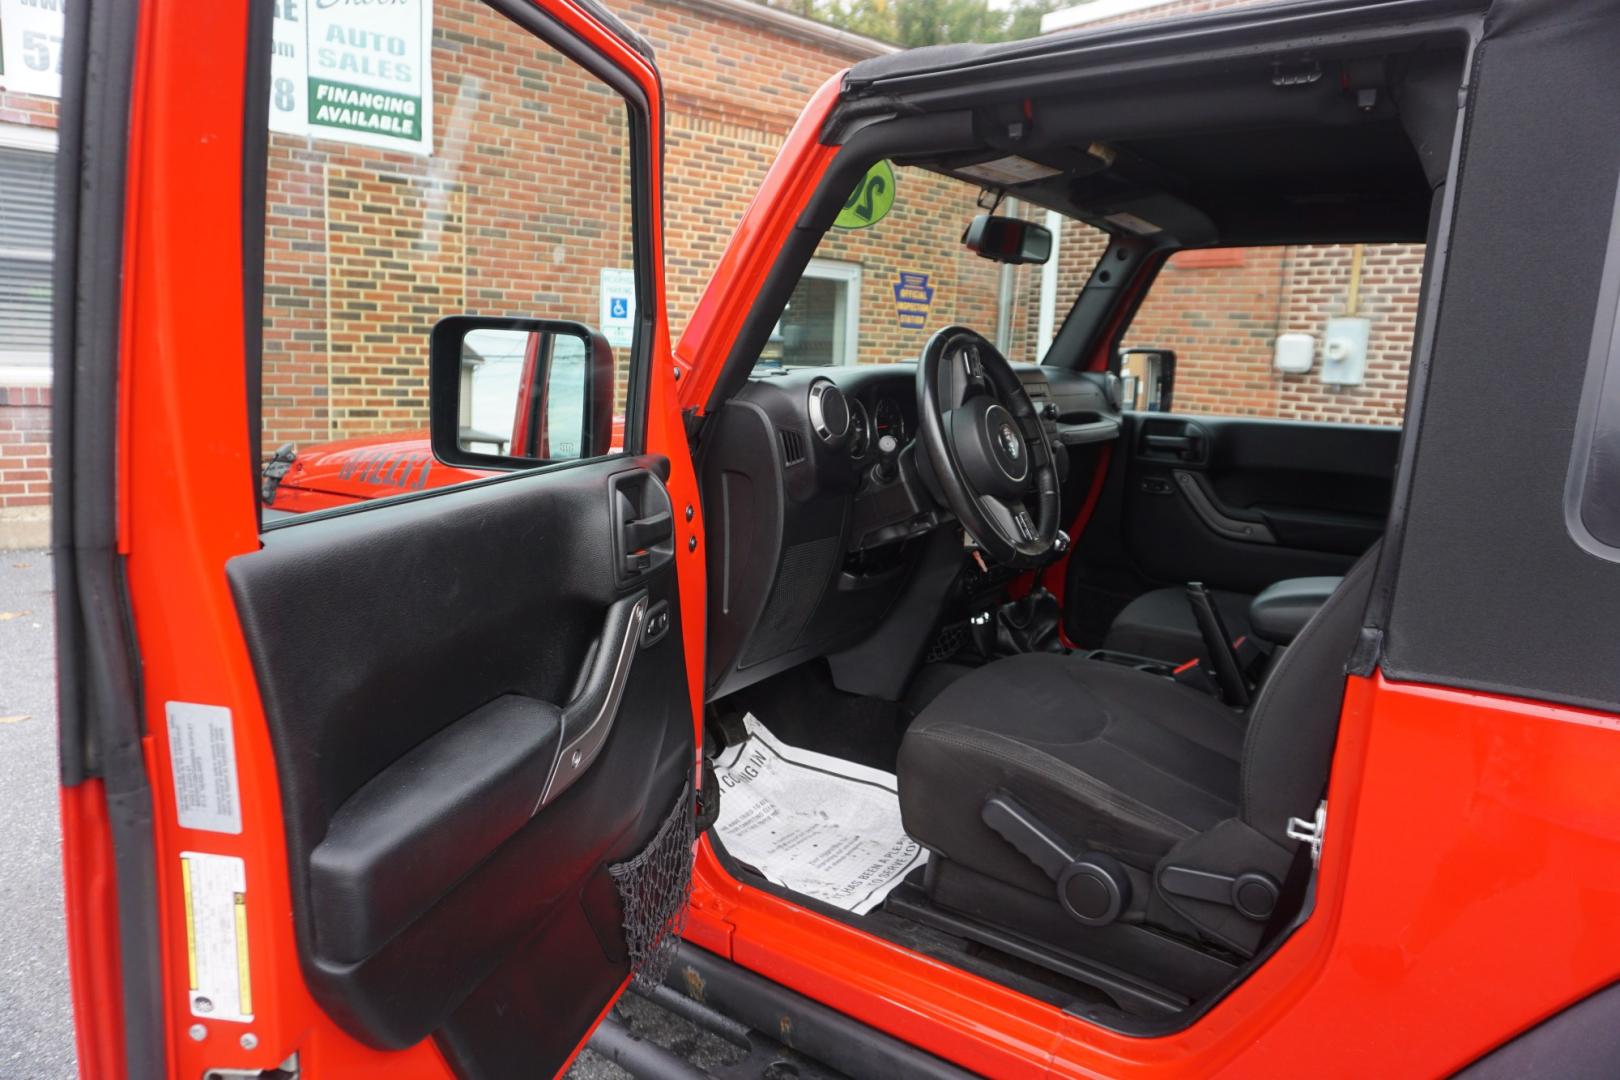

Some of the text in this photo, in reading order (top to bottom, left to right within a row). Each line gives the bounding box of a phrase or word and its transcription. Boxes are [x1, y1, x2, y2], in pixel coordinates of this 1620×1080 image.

[326, 23, 406, 56] AUTO
[318, 48, 413, 82] SALES
[316, 84, 416, 116] FINANCING
[316, 105, 414, 134] AVAILABLE
[750, 750, 767, 768] IN
[840, 880, 863, 896] HAS
[858, 863, 882, 880] BEEN
[878, 858, 908, 878] SERVE
